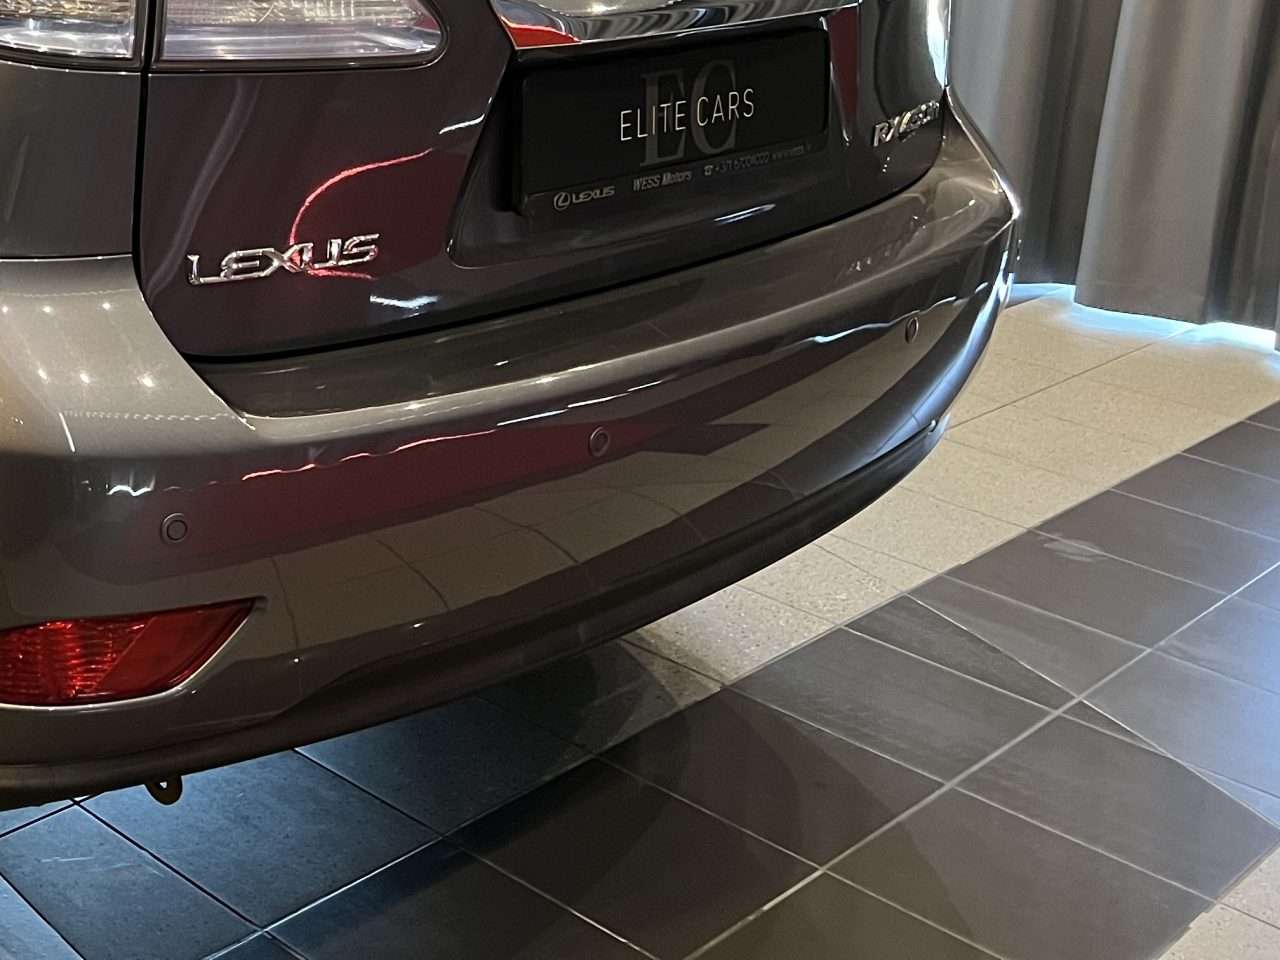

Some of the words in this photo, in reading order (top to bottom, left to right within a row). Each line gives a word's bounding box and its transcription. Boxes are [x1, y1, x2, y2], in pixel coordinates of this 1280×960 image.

[621, 100, 687, 141] ELITE
[697, 88, 754, 127] CARS
[572, 185, 616, 204] LEXUS
[632, 173, 661, 191] WESS
[187, 233, 380, 285] LEXUS
